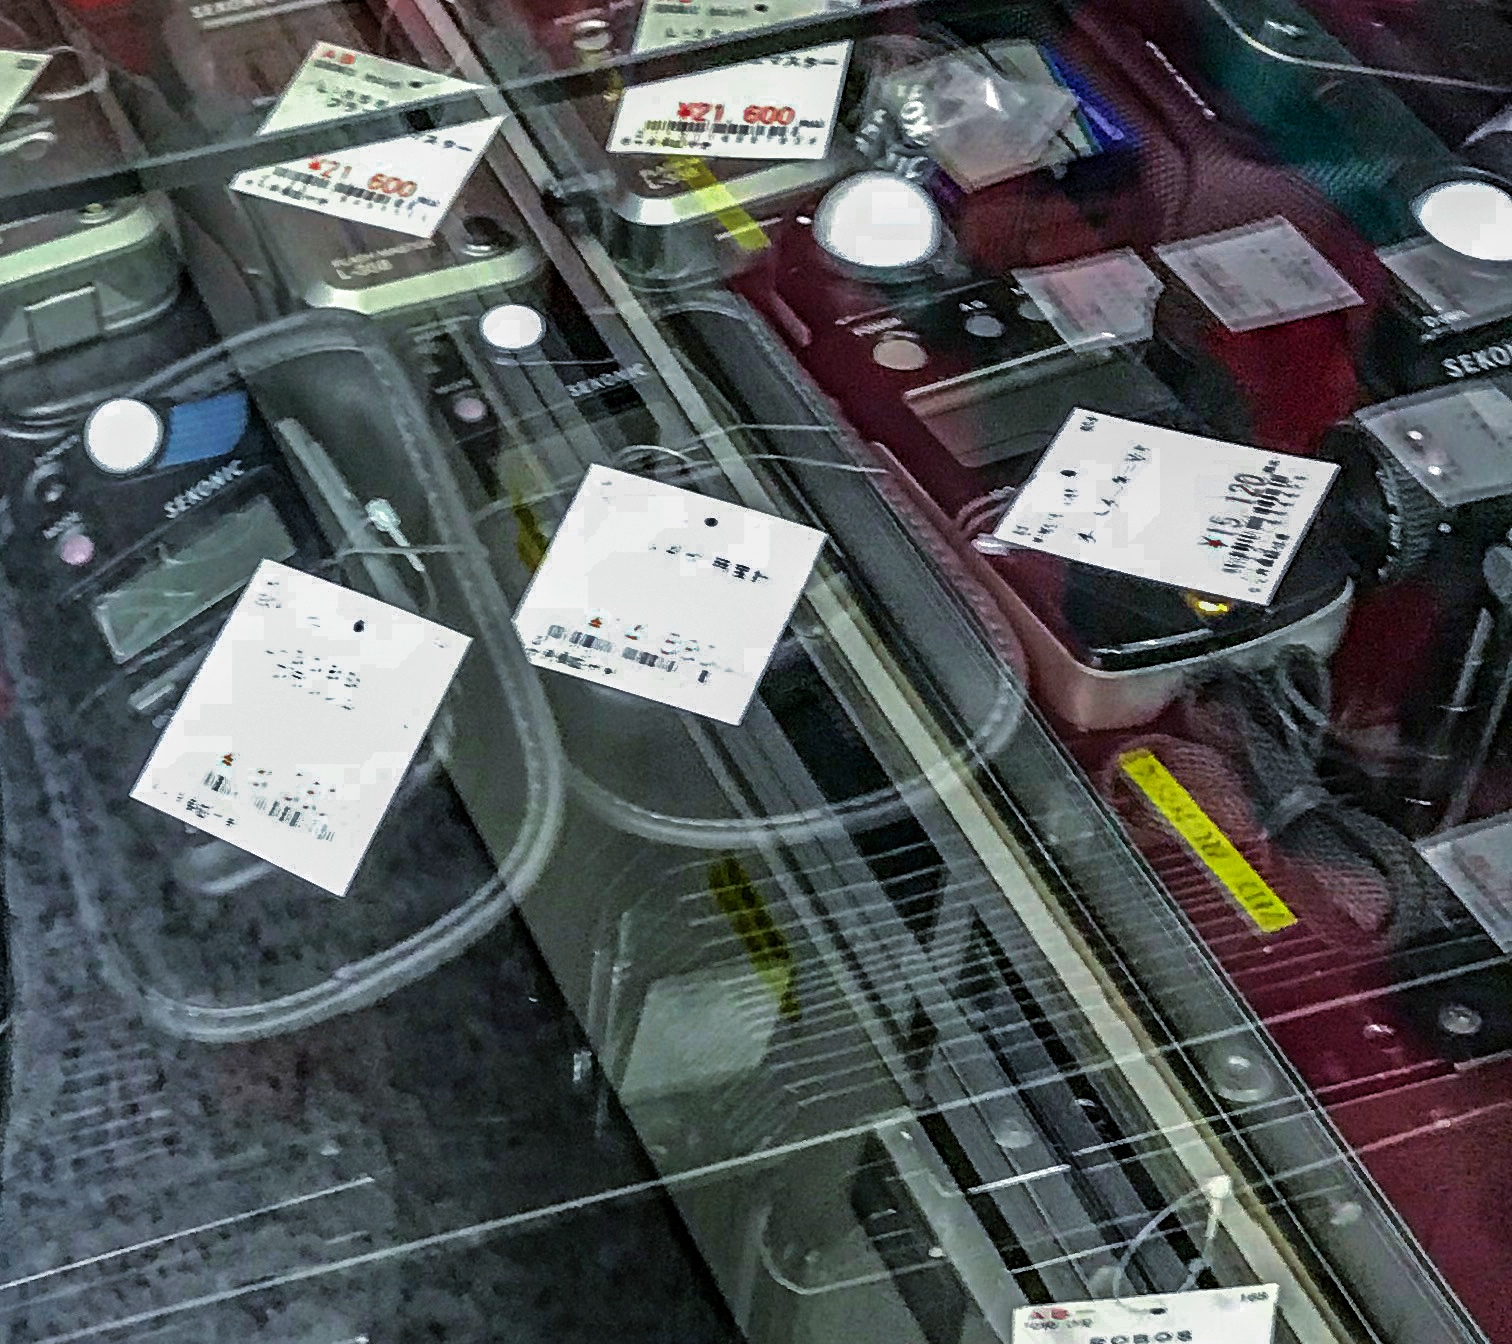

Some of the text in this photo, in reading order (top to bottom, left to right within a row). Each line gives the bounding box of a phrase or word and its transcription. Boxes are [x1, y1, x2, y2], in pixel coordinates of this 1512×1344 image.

[676, 102, 796, 126] ¥21 600
[367, 171, 419, 198] 600
